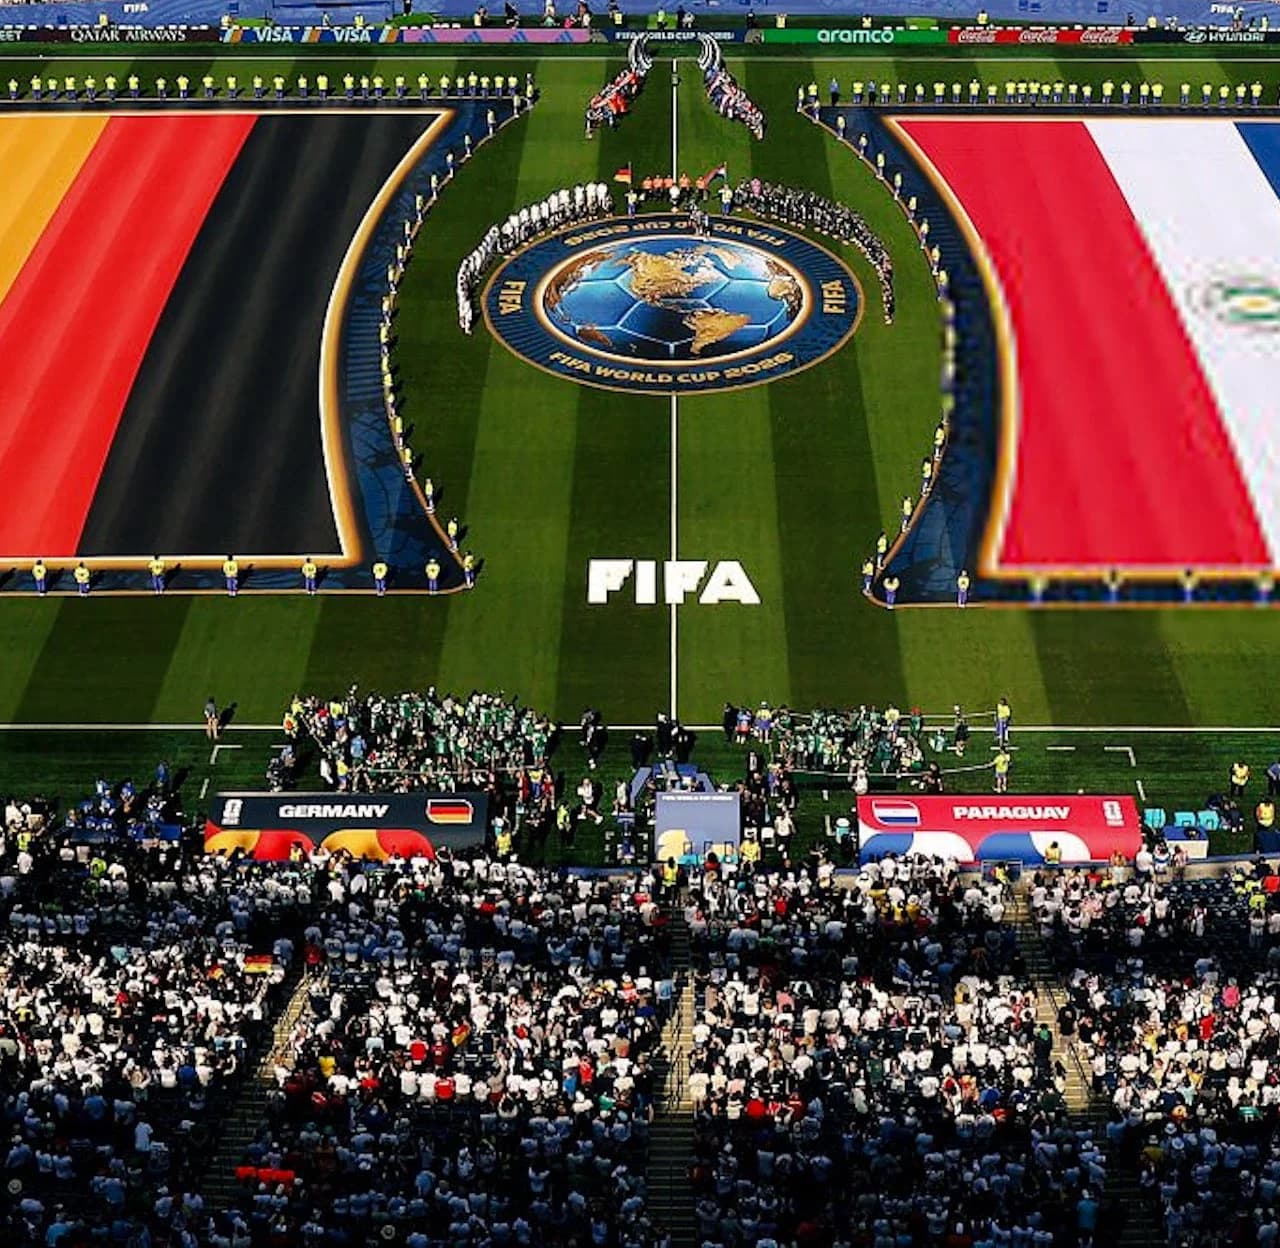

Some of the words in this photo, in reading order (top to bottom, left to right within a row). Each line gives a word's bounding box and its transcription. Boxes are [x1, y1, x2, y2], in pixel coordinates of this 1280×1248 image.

[123, 2, 149, 13] FIFA
[70, 29, 120, 43] QATAR
[125, 29, 188, 42] AIRWAYS
[253, 29, 294, 43] VISA
[331, 29, 372, 43] VISA
[816, 30, 896, 43] aramco
[1209, 33, 1266, 43] HYUNDAI
[498, 280, 527, 316] FIFA
[821, 280, 847, 314] FIFA
[549, 350, 591, 373] FIFA
[594, 364, 673, 384] WORLD
[676, 370, 721, 384] CUP
[723, 350, 795, 380] 2026
[587, 558, 762, 605] FIFA
[279, 804, 390, 819] GERMANY
[952, 805, 1071, 821] PARAGUAY
